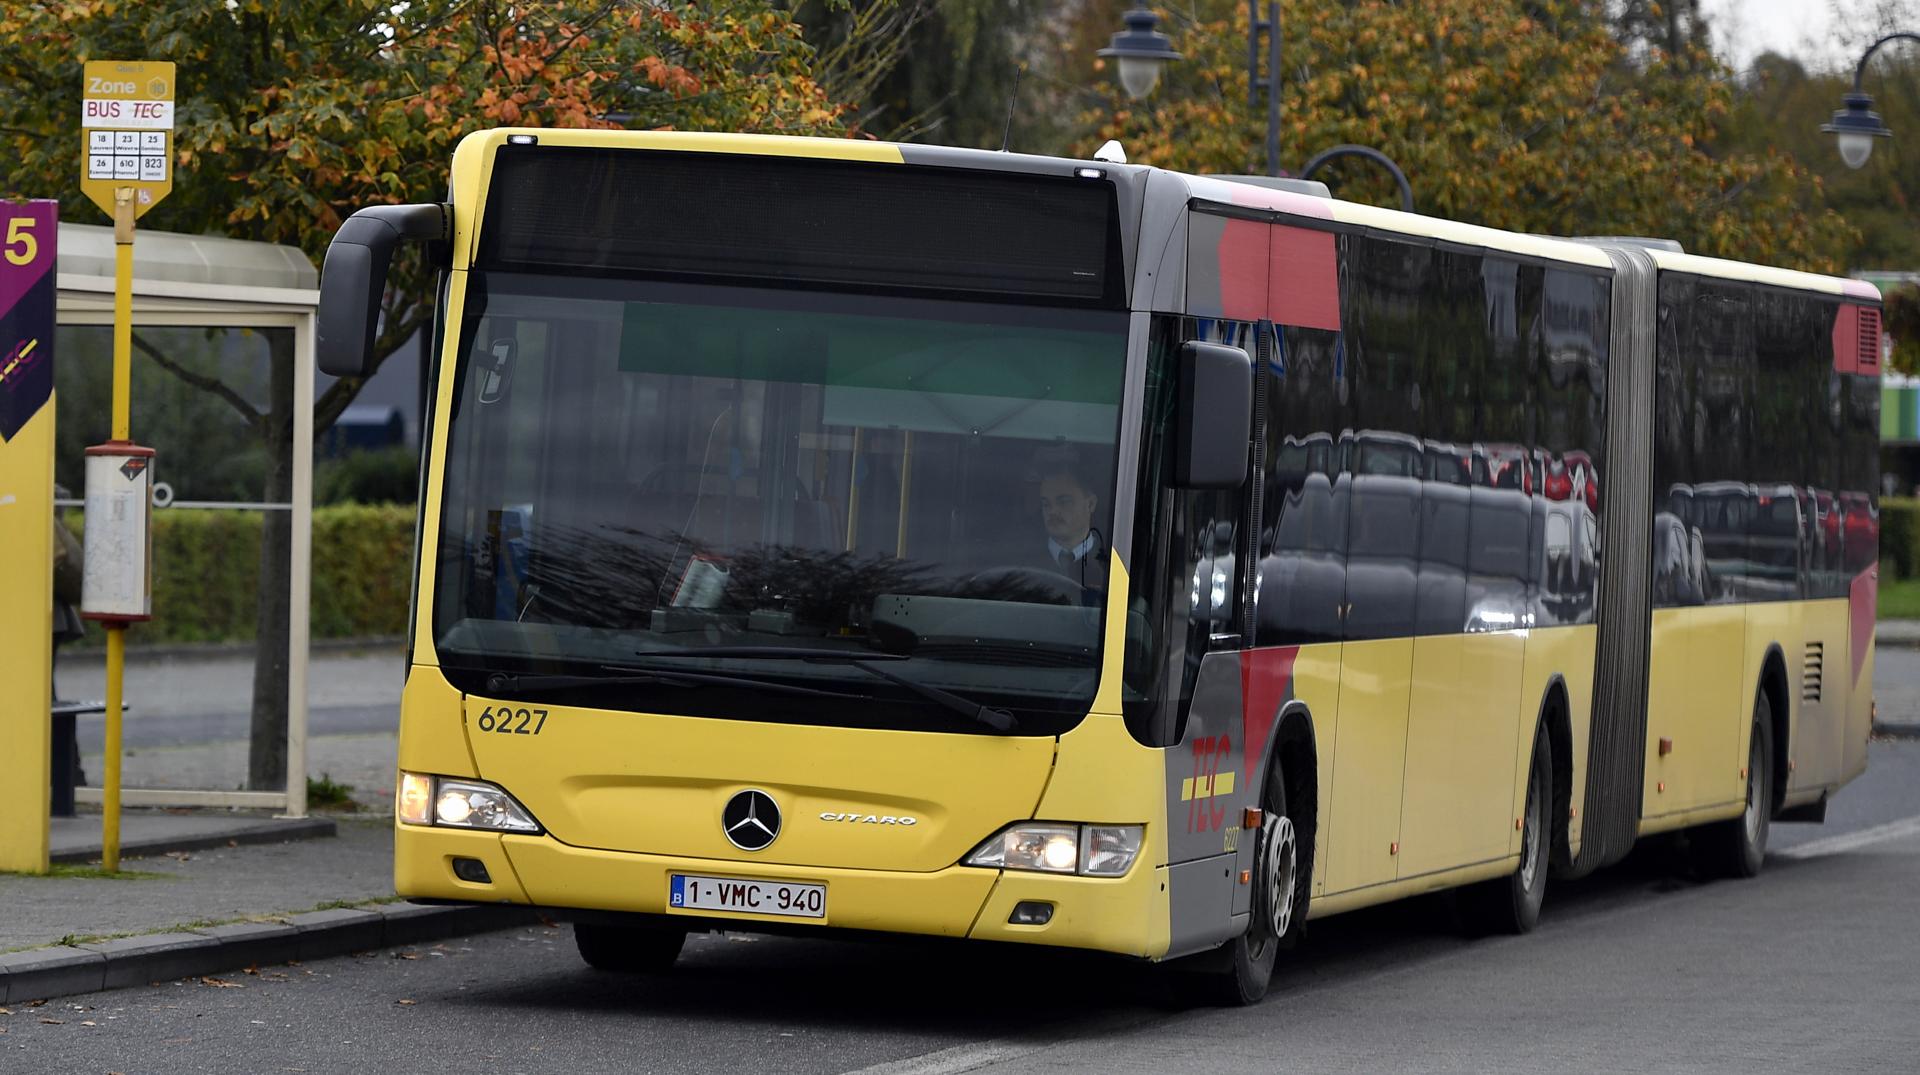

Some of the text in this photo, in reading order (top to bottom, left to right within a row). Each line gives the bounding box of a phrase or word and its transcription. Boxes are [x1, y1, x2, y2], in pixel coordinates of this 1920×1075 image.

[88, 77, 136, 94] Zone
[87, 101, 164, 119] BUS TEC
[122, 135, 132, 143] 23
[145, 158, 162, 168] 823
[4, 217, 37, 265] 5
[478, 706, 548, 735] 6227
[1187, 733, 1231, 834] TEC
[820, 812, 917, 826] CITARO
[1223, 825, 1239, 852] 6227
[673, 893, 682, 904] B
